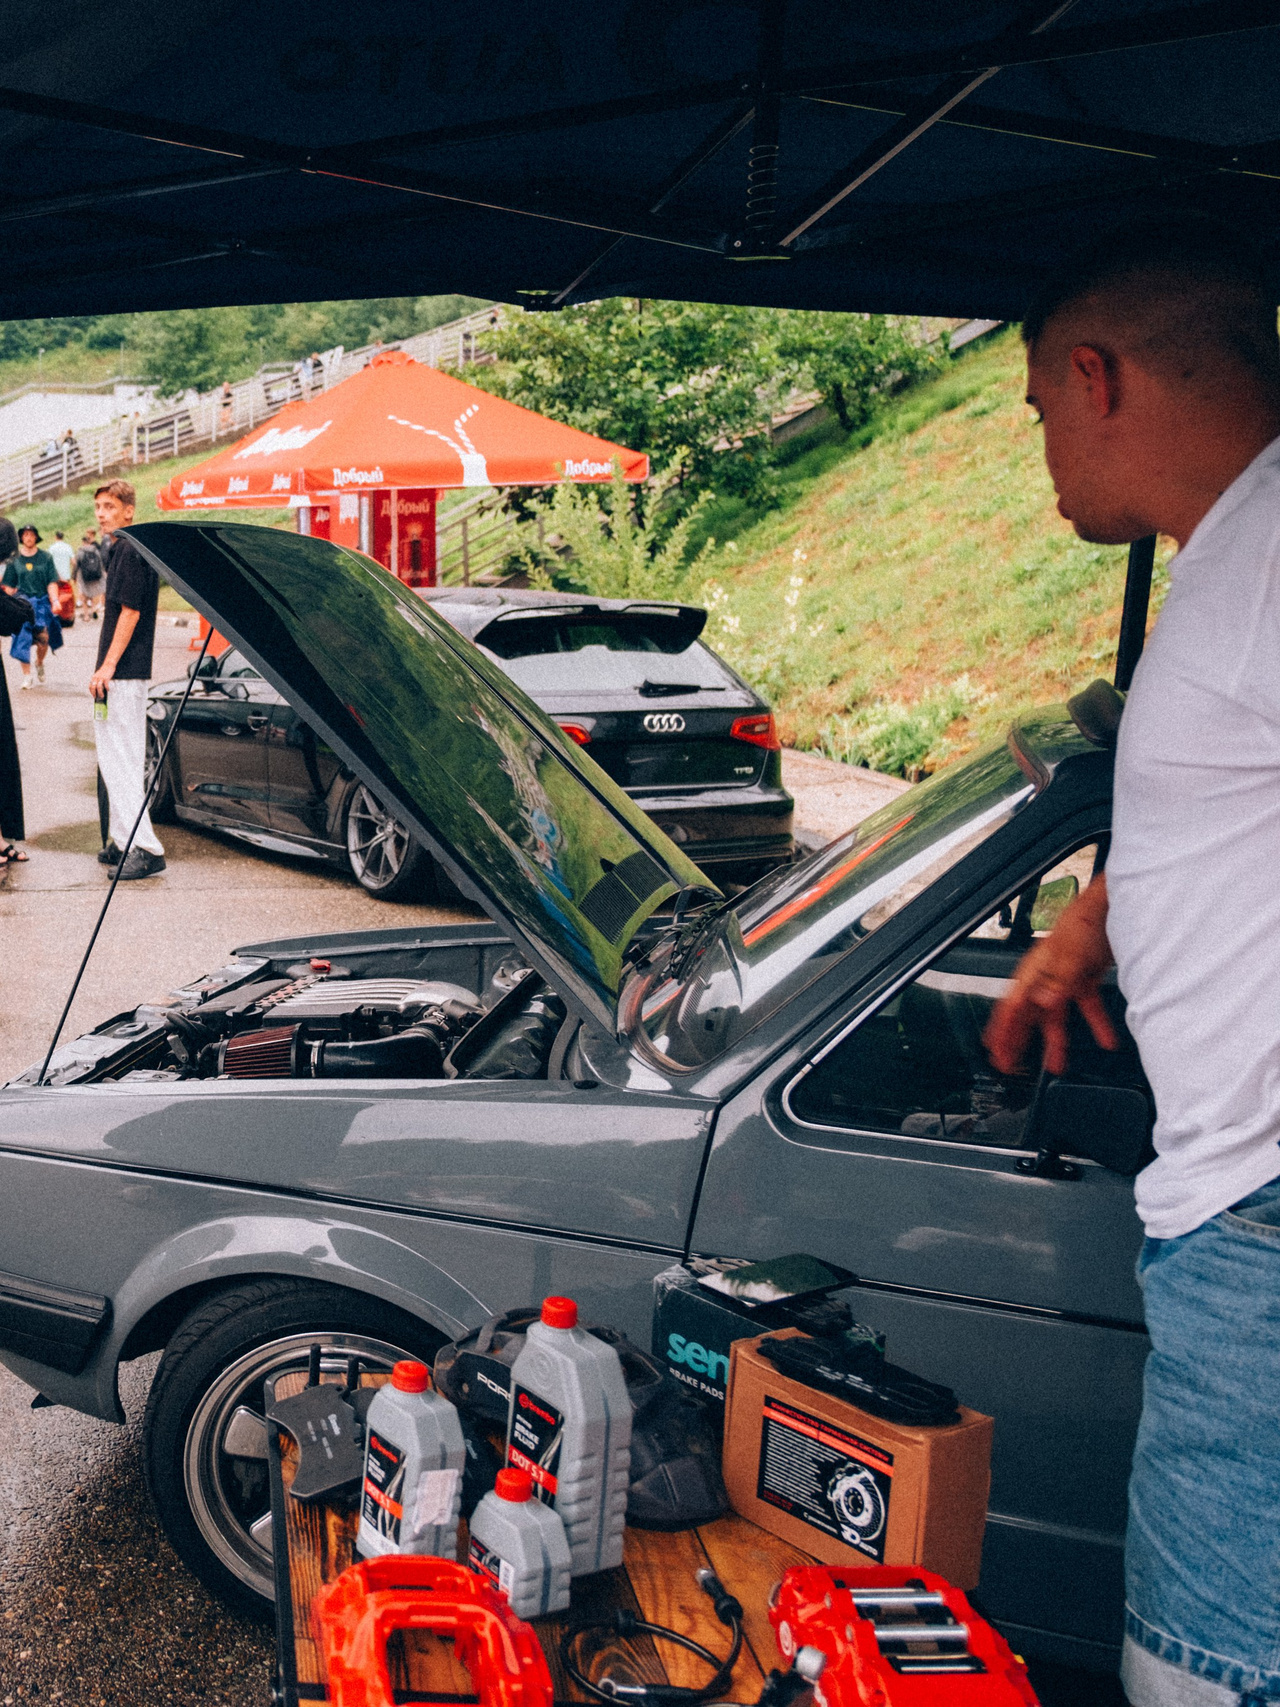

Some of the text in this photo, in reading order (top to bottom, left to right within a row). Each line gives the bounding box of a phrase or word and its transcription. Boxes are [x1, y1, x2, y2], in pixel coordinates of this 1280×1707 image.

[333, 466, 384, 487] Добрый
[381, 498, 430, 517] Дбрый
[666, 1332, 730, 1385] sen
[700, 1382, 725, 1401] PADS
[511, 1448, 530, 1472] DOT
